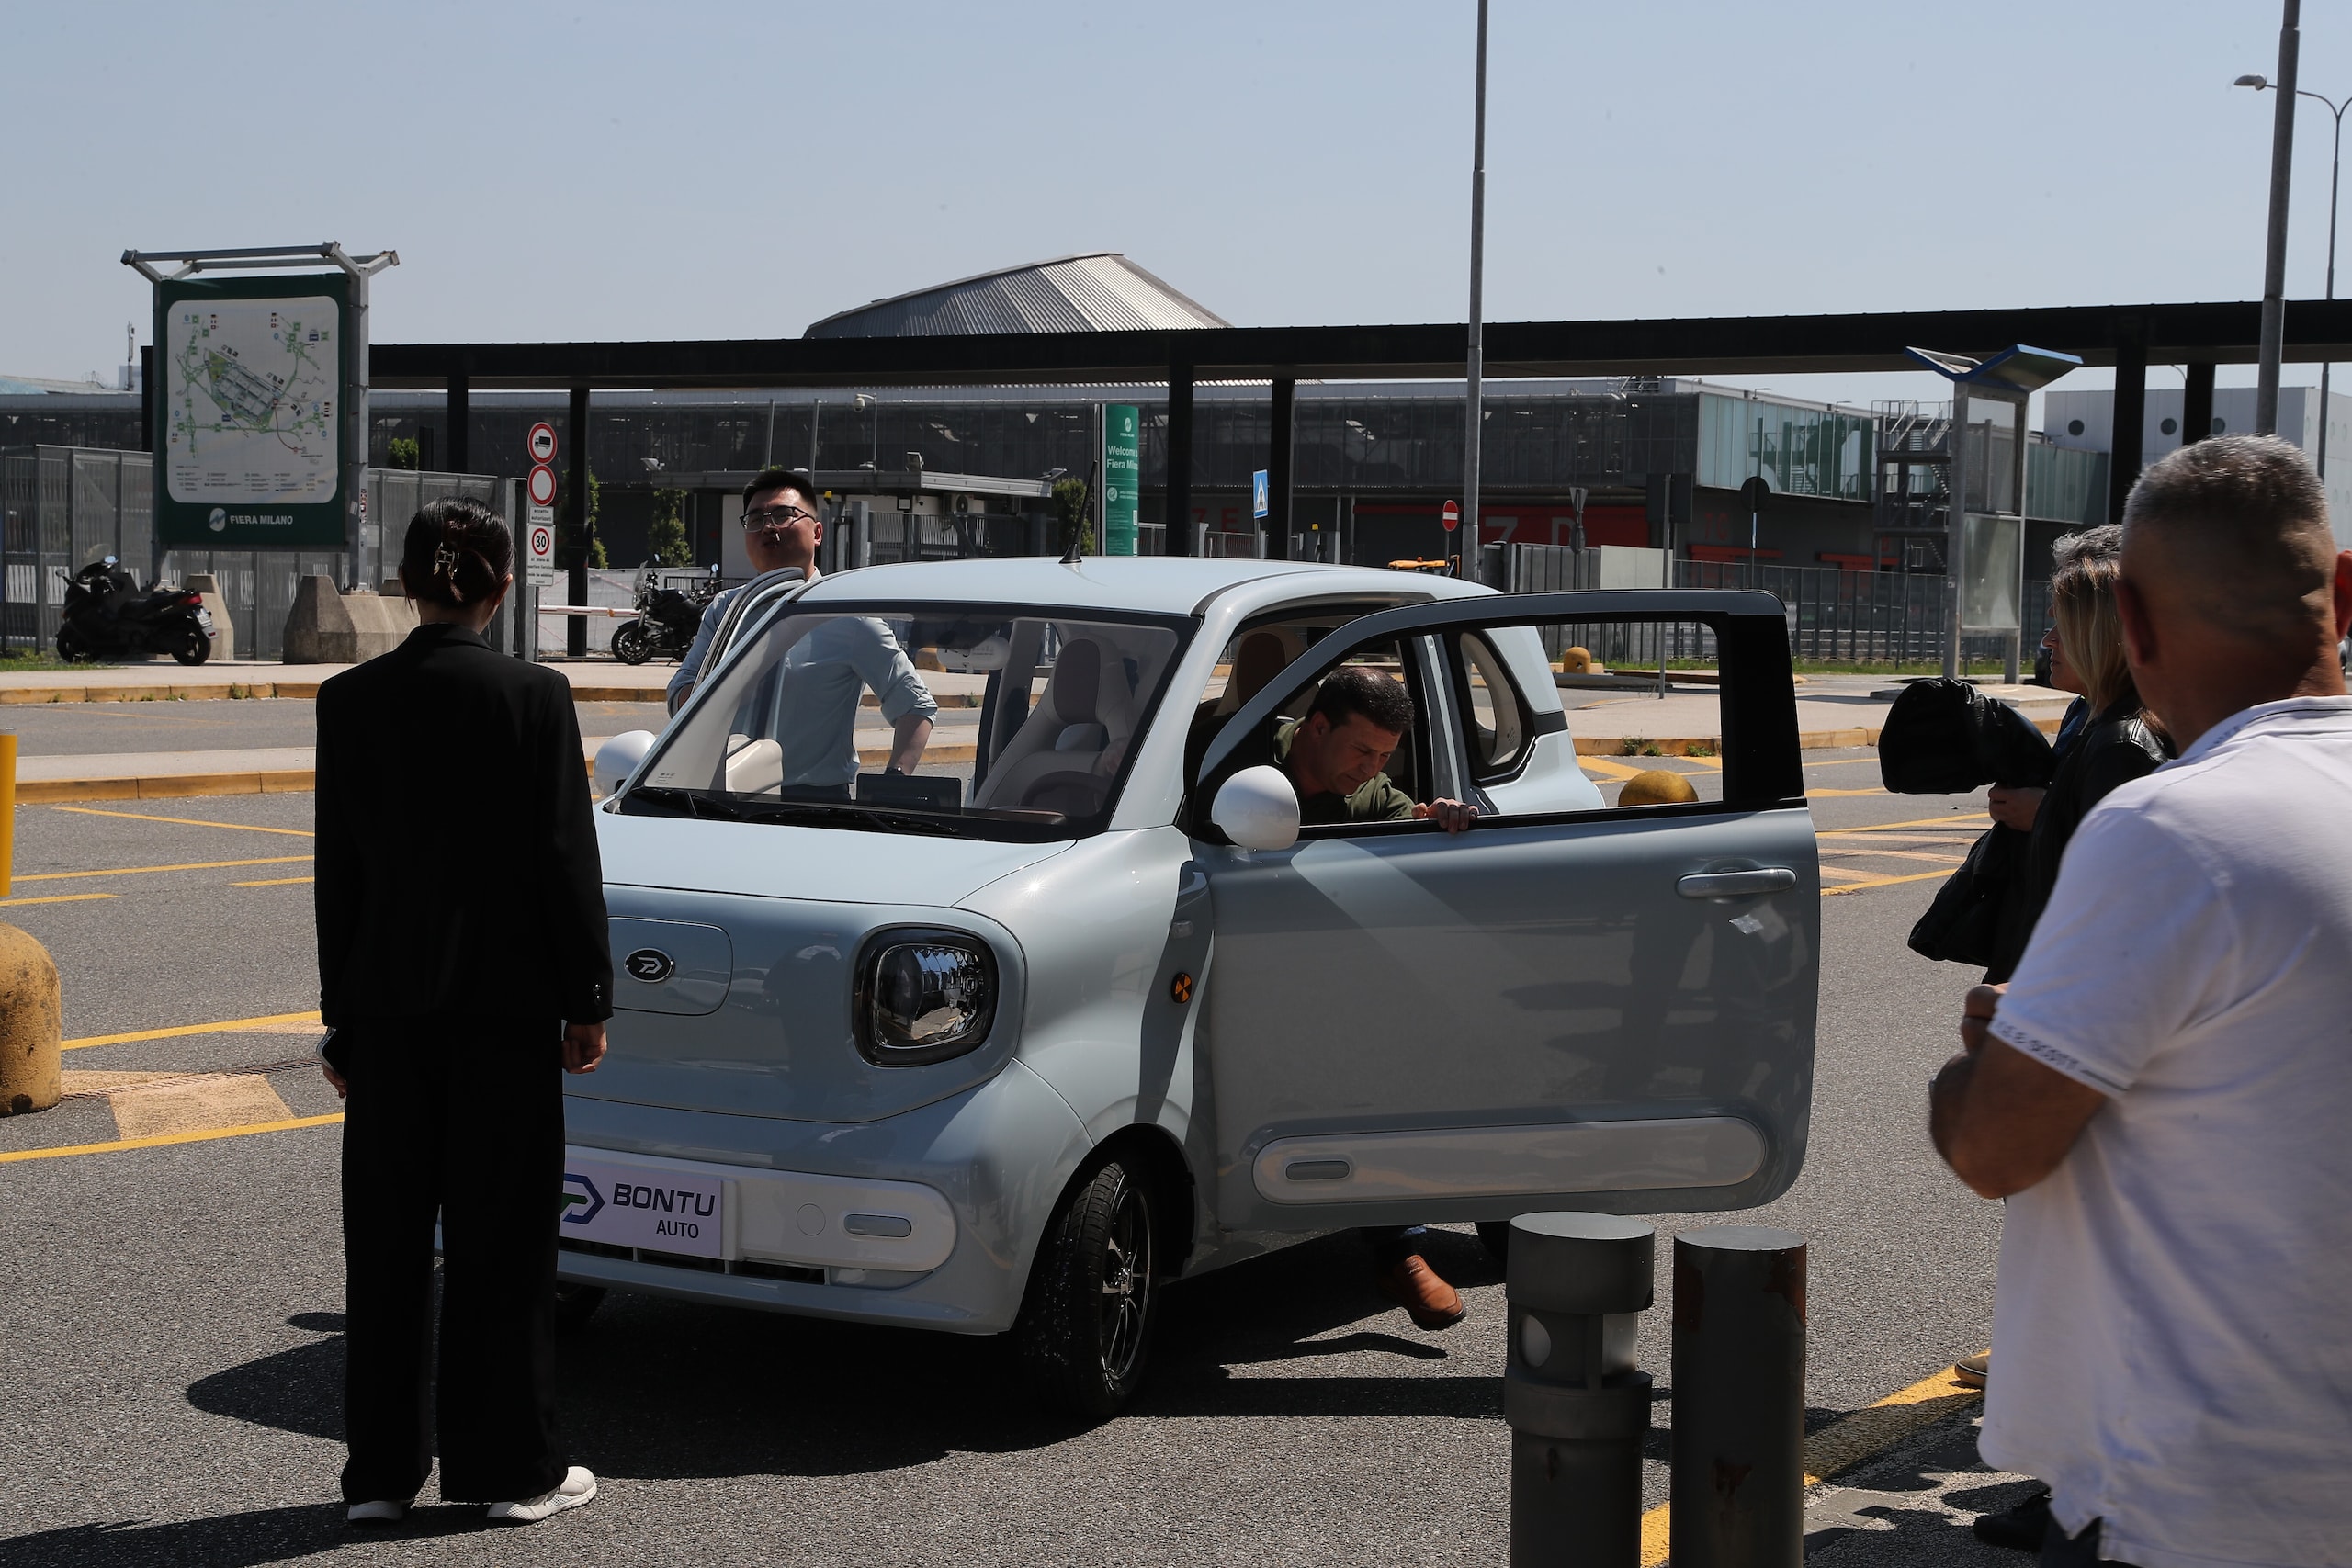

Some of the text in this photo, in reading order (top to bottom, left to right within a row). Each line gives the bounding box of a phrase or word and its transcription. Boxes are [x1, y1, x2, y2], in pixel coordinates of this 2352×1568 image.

[1107, 459, 1126, 469] Fiera
[230, 515, 294, 526] FIERA MILANO
[536, 535, 547, 547] 30
[613, 1182, 716, 1217] BONTU
[655, 1219, 699, 1239] AUTO
